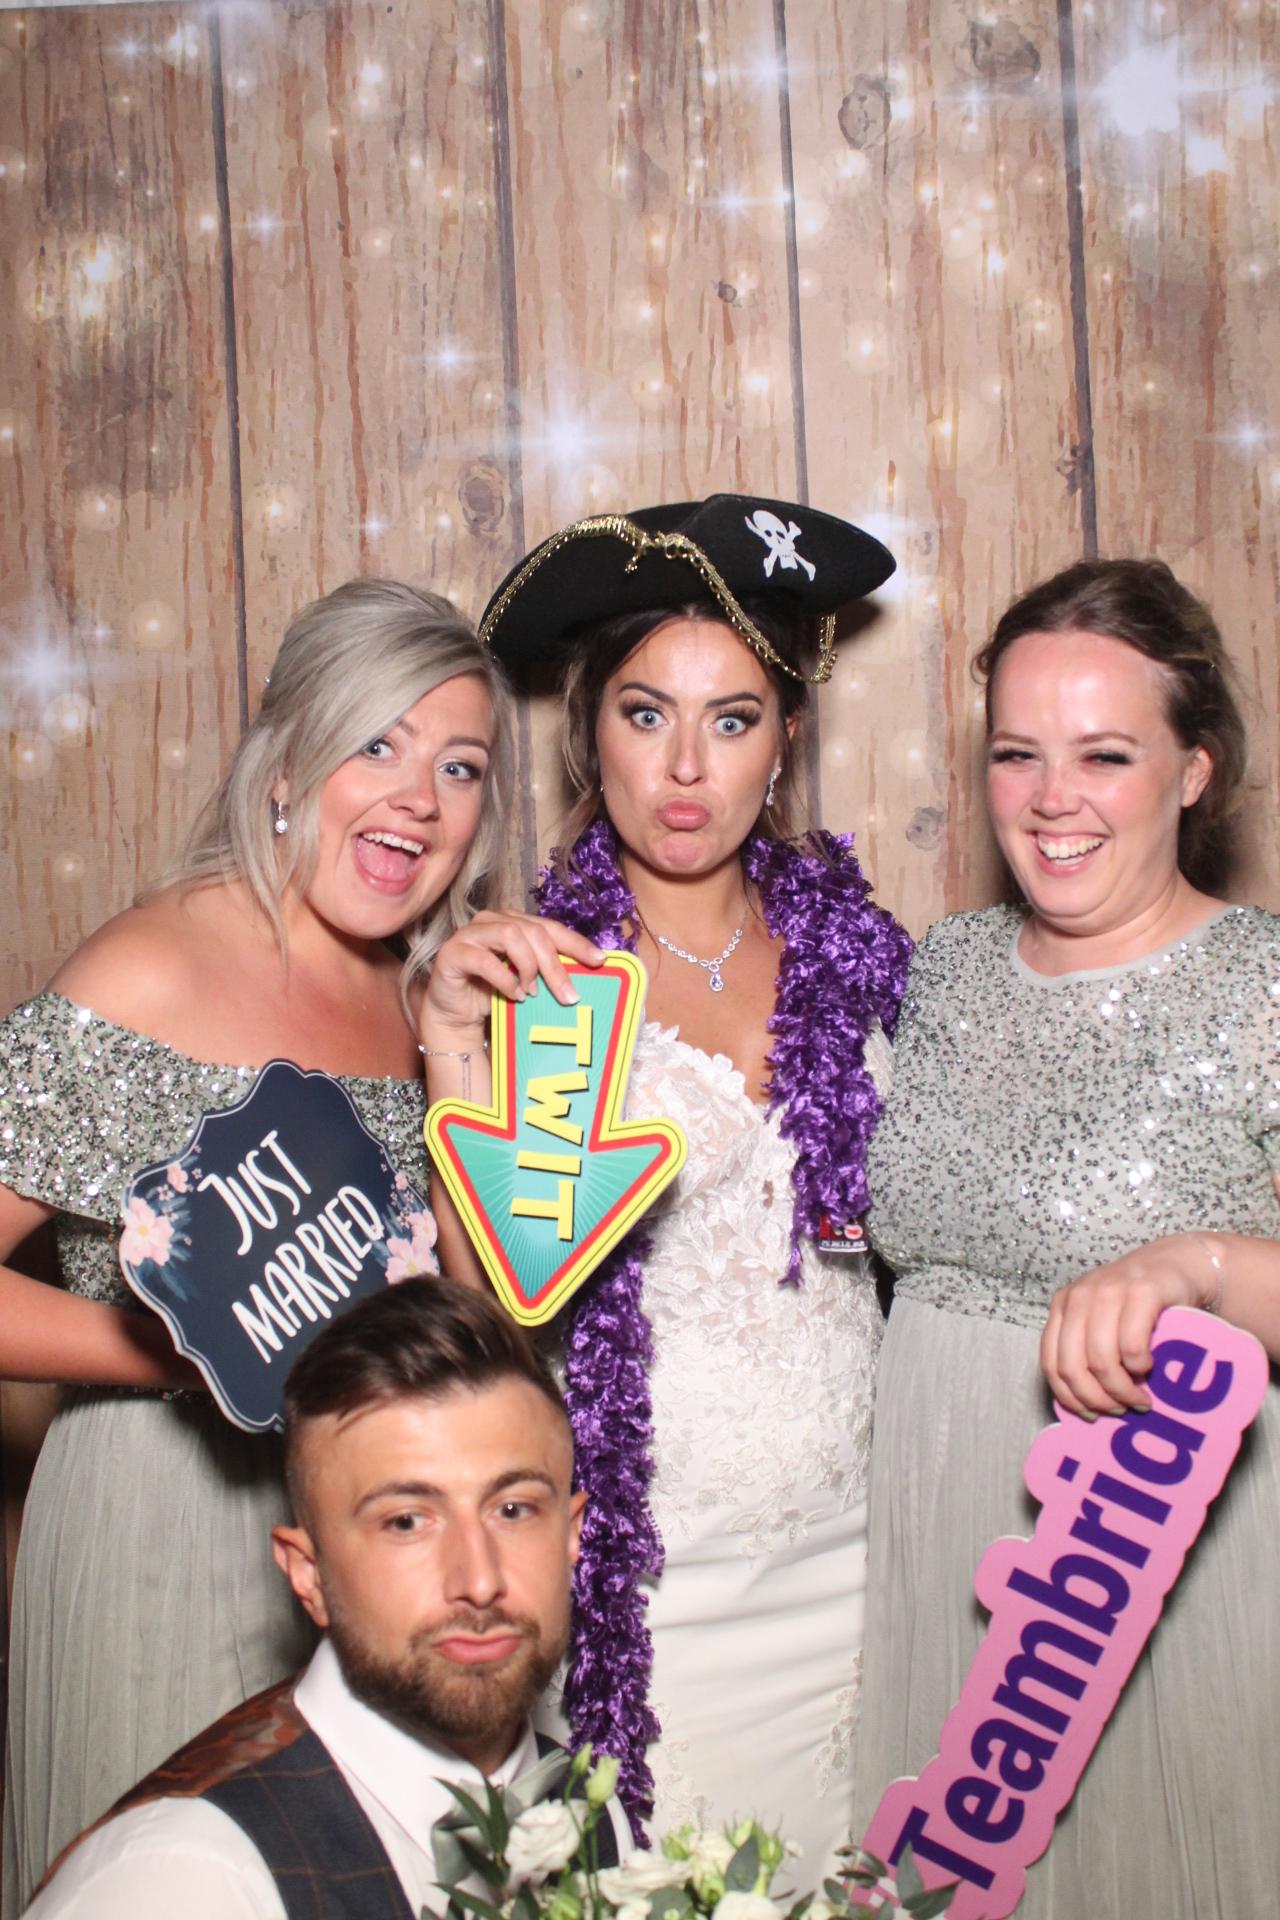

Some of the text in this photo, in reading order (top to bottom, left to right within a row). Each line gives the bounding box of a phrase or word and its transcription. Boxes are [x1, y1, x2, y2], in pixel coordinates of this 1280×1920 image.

[197, 1130, 312, 1256] JUST
[510, 1005, 593, 1242] TWIT
[231, 1186, 385, 1364] MARRIED
